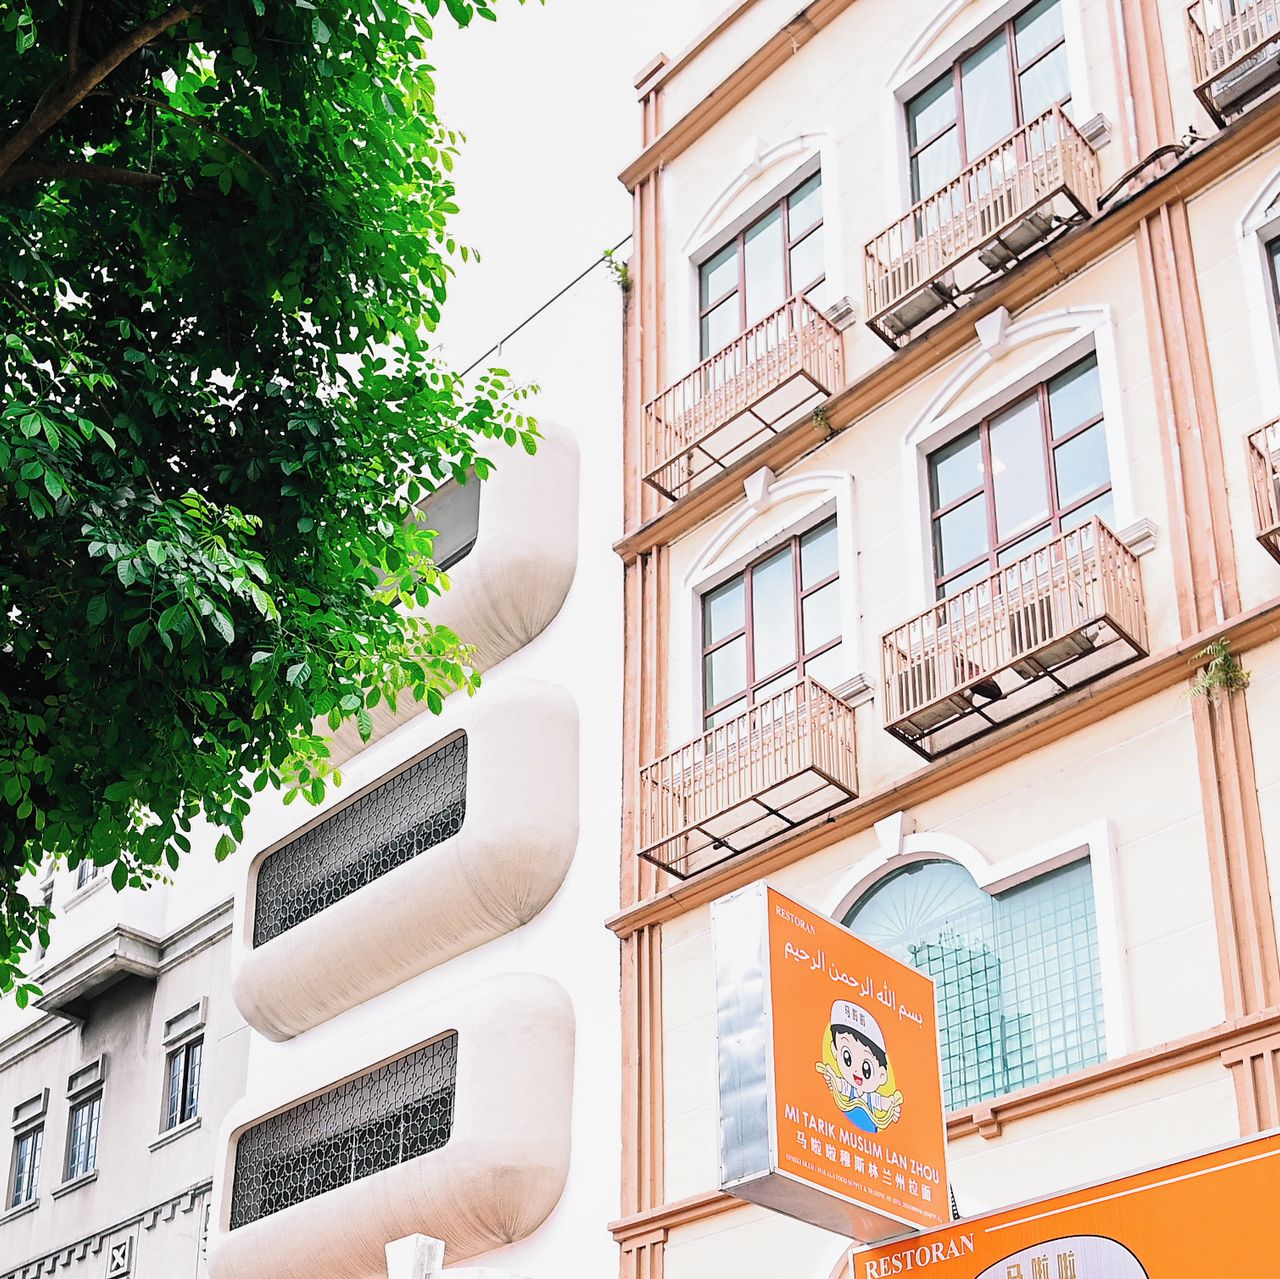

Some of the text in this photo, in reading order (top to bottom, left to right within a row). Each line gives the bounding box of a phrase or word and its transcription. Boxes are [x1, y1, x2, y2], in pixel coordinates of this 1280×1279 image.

[775, 904, 816, 936] RESTORAN
[784, 942, 826, 972] الرحيم
[829, 963, 874, 998] الرحمن
[898, 1004, 923, 1029] بسم
[784, 1103, 940, 1185] MI TARIK MUSLIM LAN ZHOU
